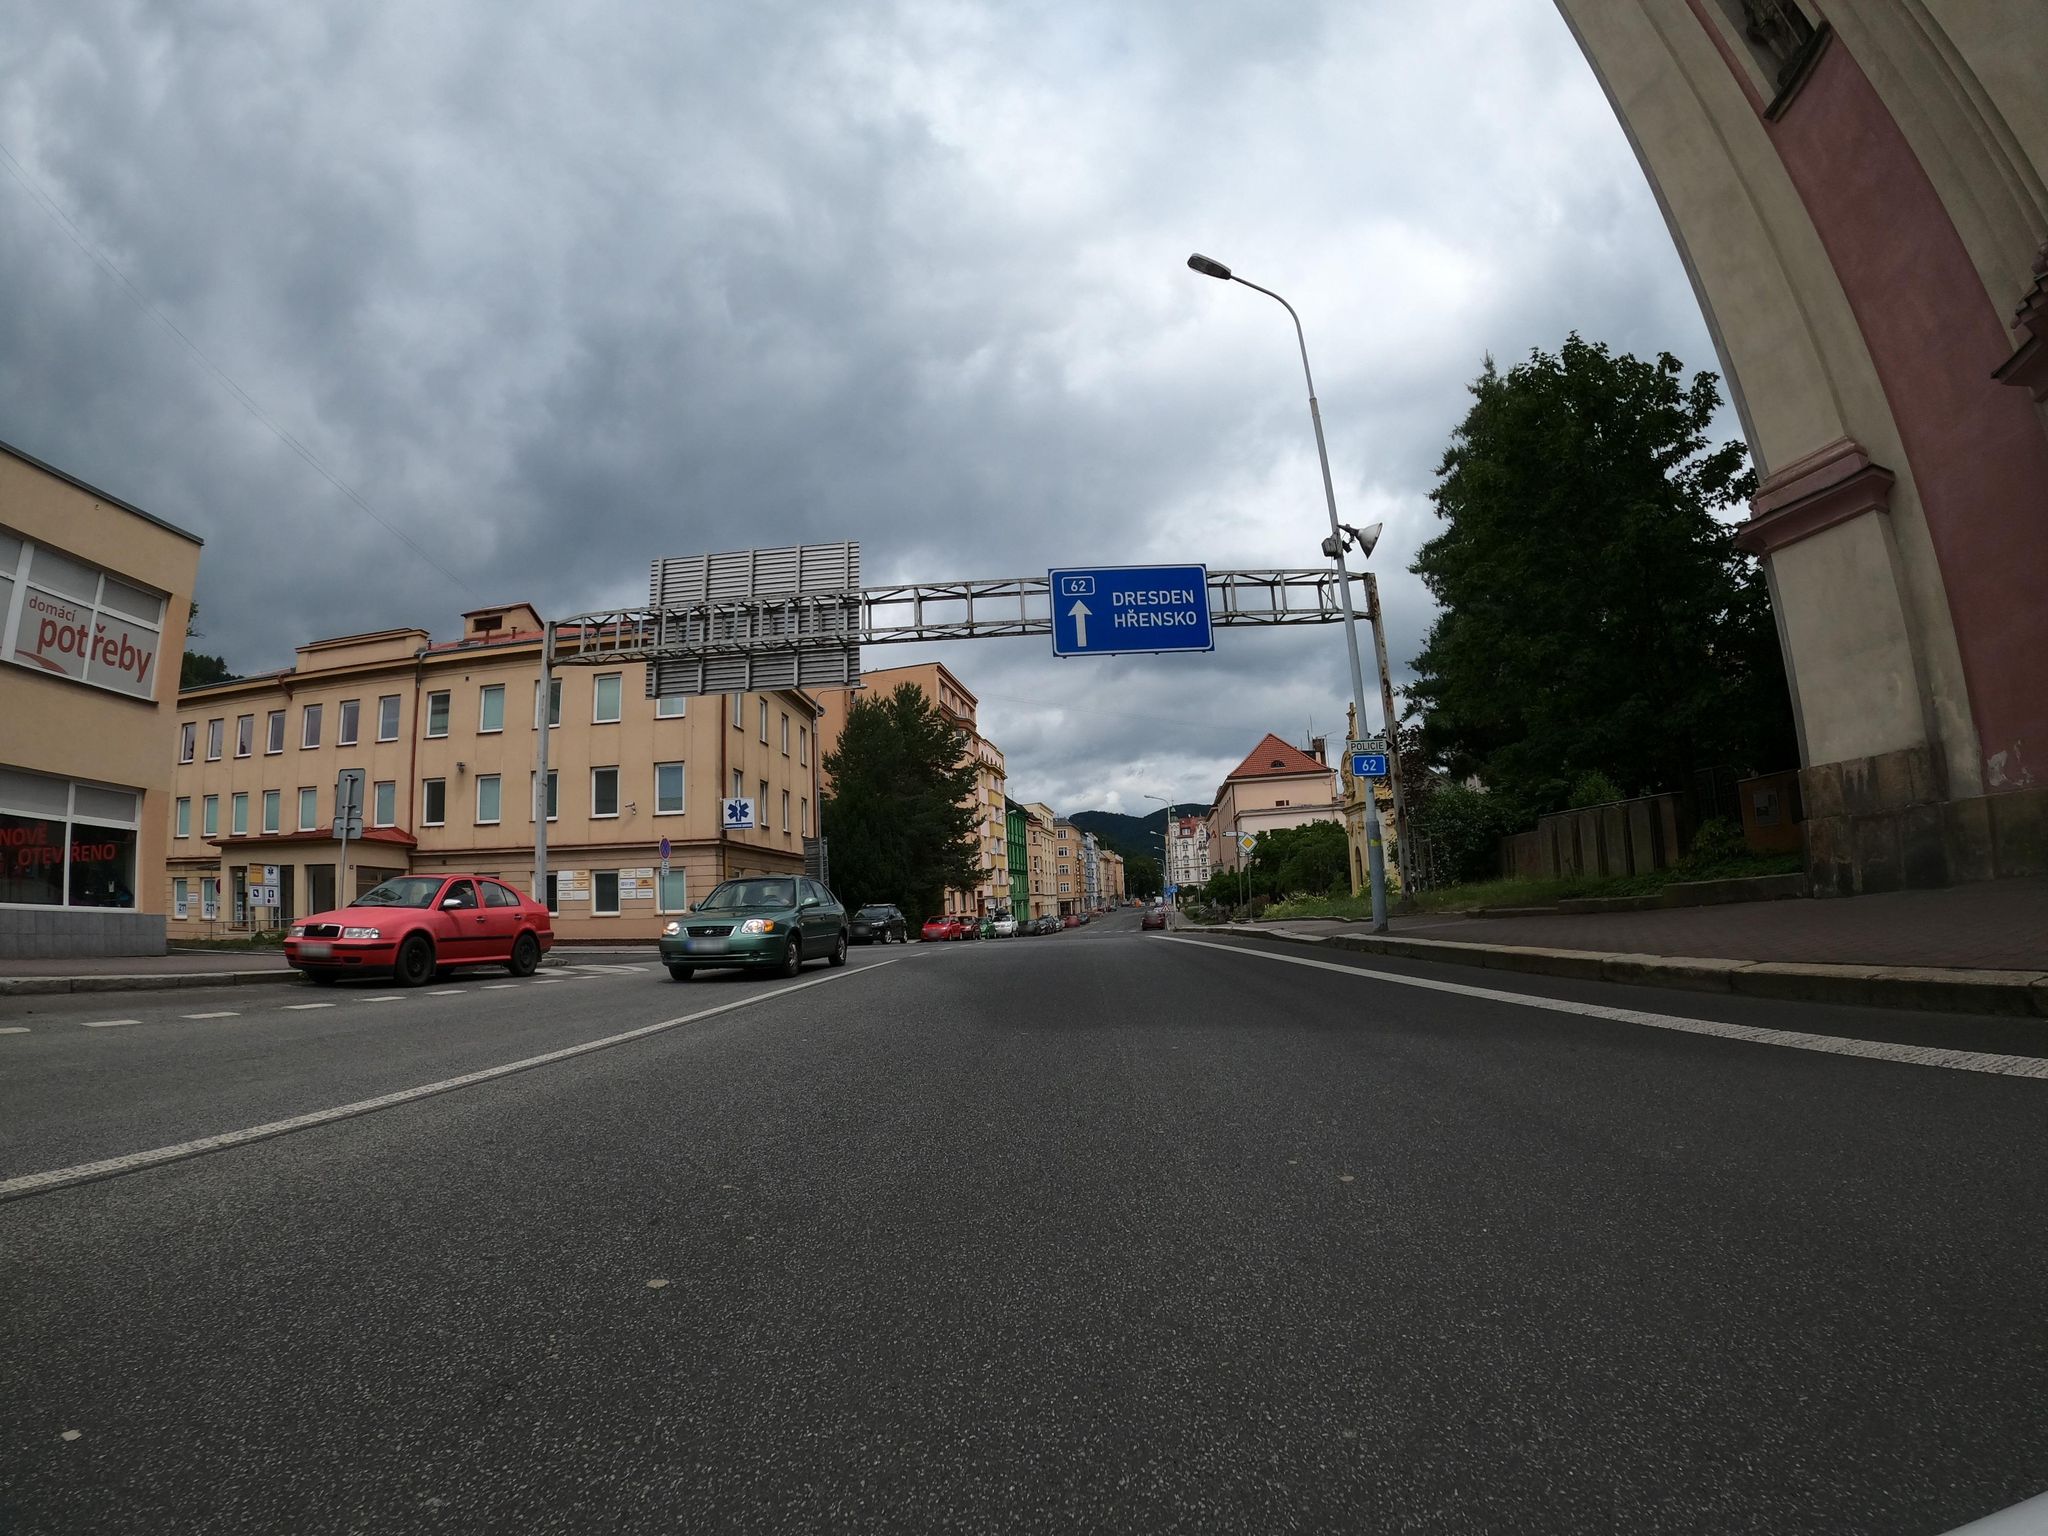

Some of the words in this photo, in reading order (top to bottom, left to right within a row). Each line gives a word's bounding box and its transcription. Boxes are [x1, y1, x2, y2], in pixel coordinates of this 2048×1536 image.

[1070, 580, 1087, 592] 62
[1112, 589, 1194, 606] DRESDEN
[29, 595, 77, 622] domácí
[1114, 609, 1197, 628] HŘENSKO
[37, 617, 152, 683] potřeby
[1351, 741, 1384, 751] POLICIE
[1362, 759, 1377, 771] 62
[17, 841, 117, 866] OTEVŘENO
